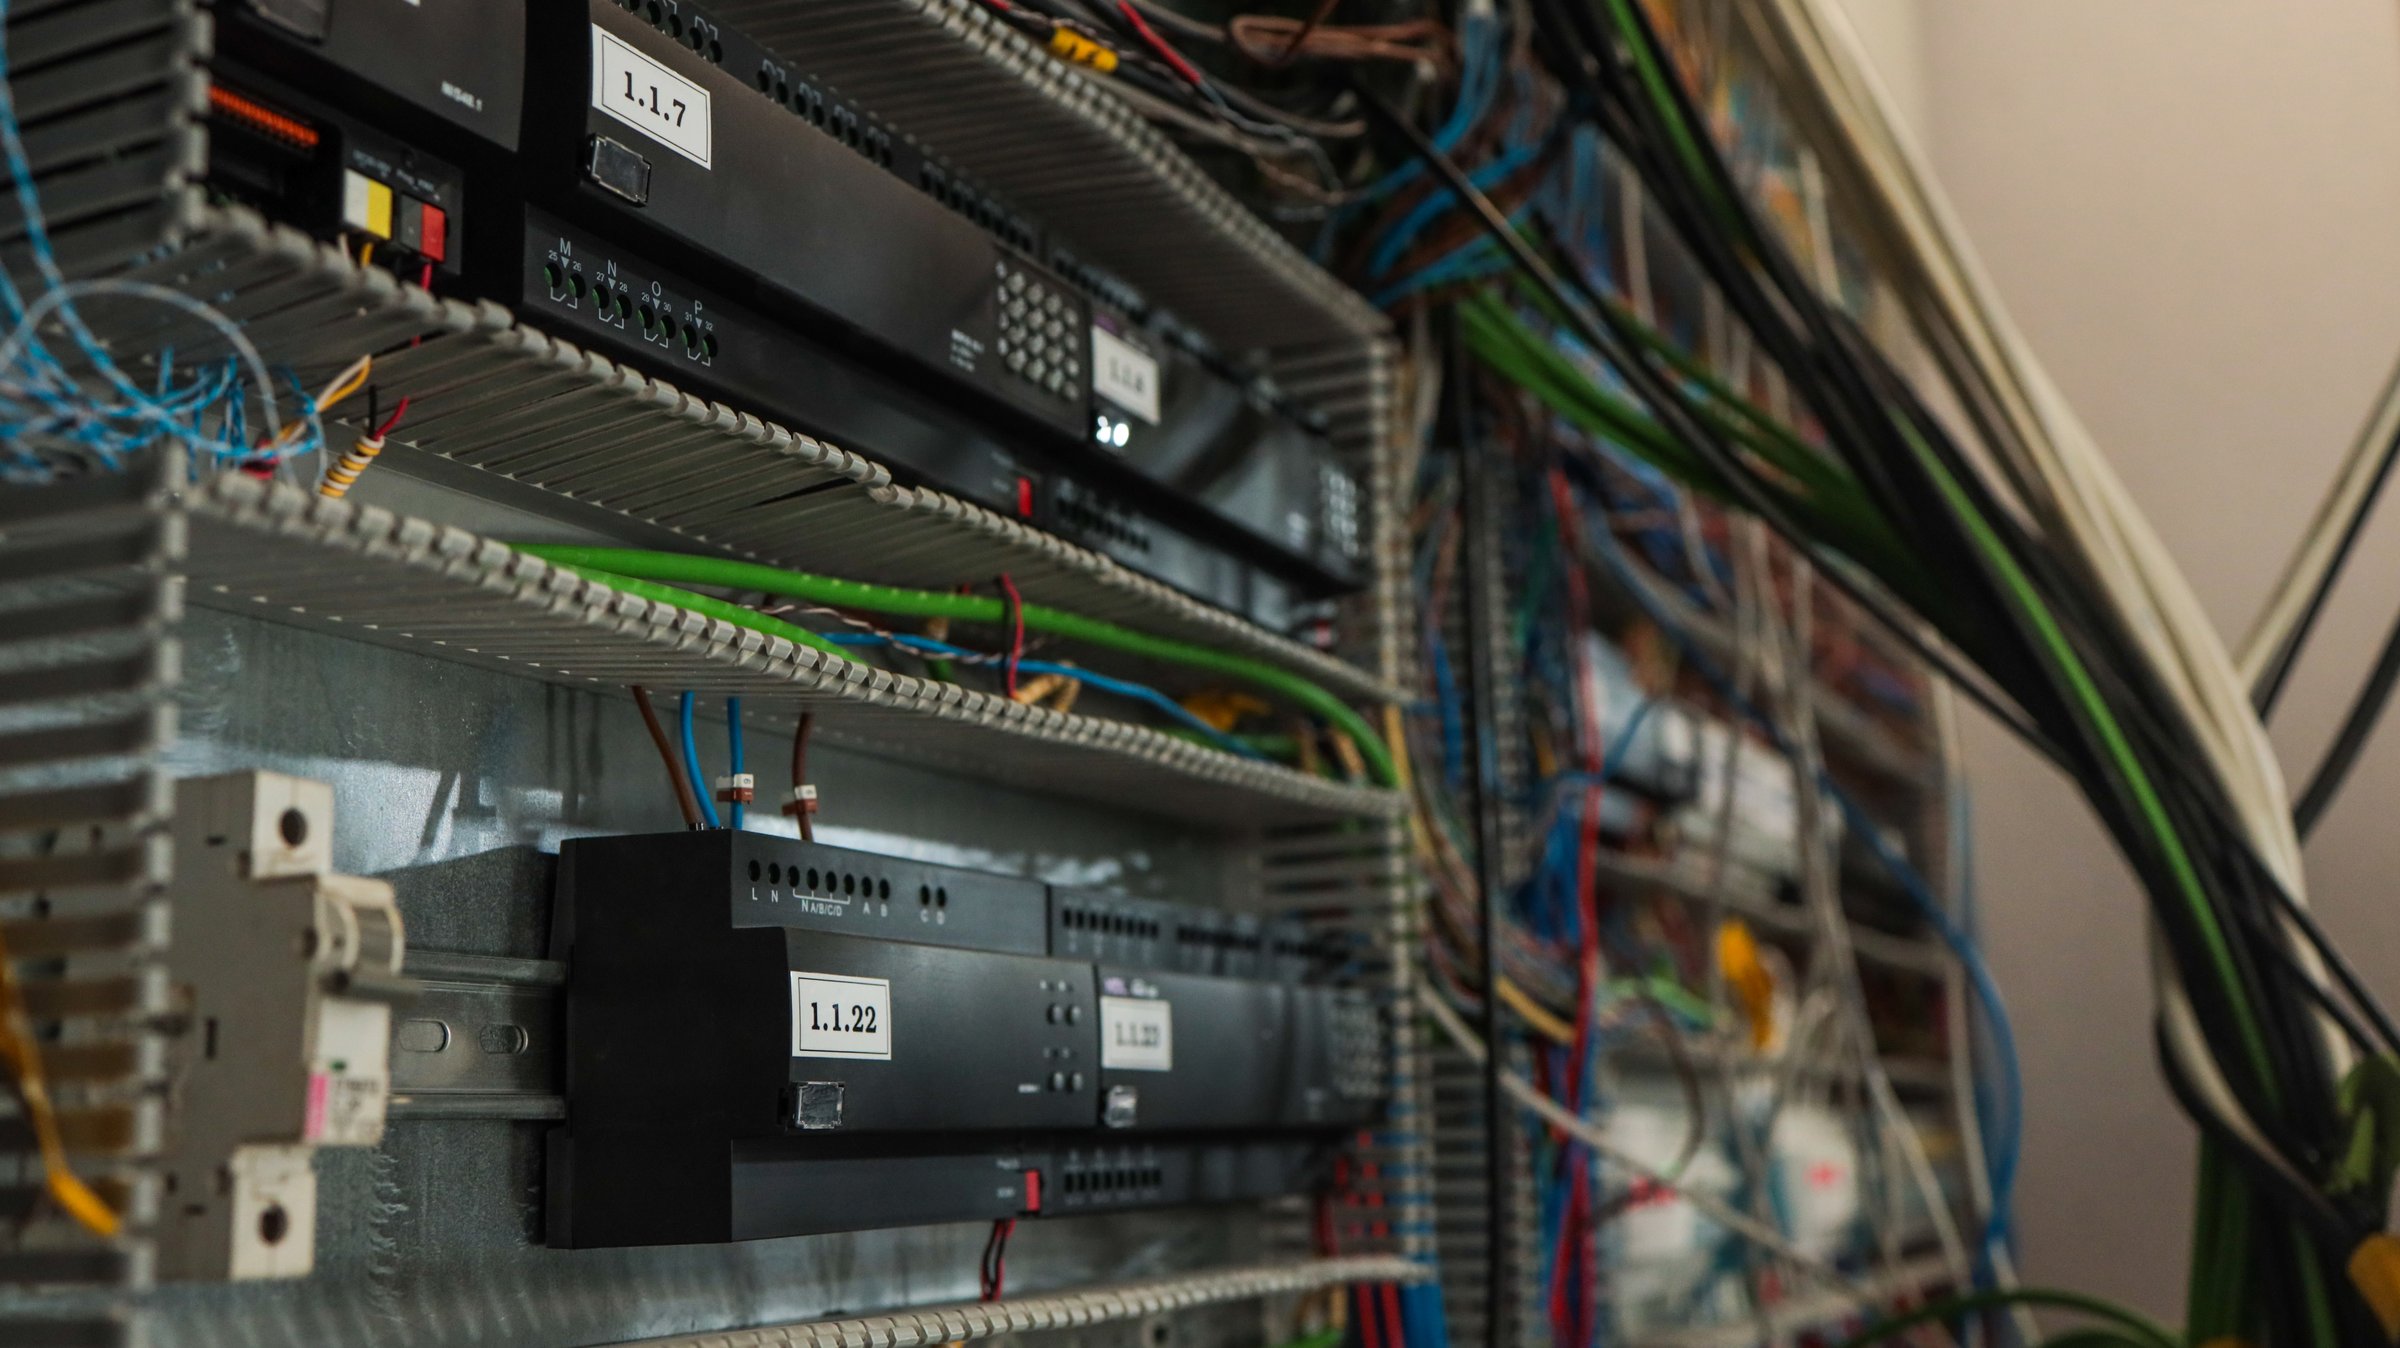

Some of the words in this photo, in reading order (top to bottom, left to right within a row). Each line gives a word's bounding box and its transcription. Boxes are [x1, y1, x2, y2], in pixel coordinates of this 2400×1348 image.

[624, 71, 686, 127] 1.1.7
[548, 250, 558, 262] 25
[572, 260, 582, 272] 26
[560, 237, 571, 257] M
[607, 259, 617, 278] N
[651, 281, 662, 297] O
[694, 300, 703, 315] P
[596, 271, 605, 282] 27
[619, 282, 628, 293] 28
[641, 292, 650, 303] 29
[663, 301, 672, 313] 30
[684, 312, 693, 322] 31
[705, 321, 714, 331] 32
[752, 887, 758, 901] L
[771, 890, 779, 903] N
[863, 902, 871, 915] A
[880, 904, 888, 917] B
[920, 909, 929, 923] C
[811, 1002, 877, 1033] 1.1.22
